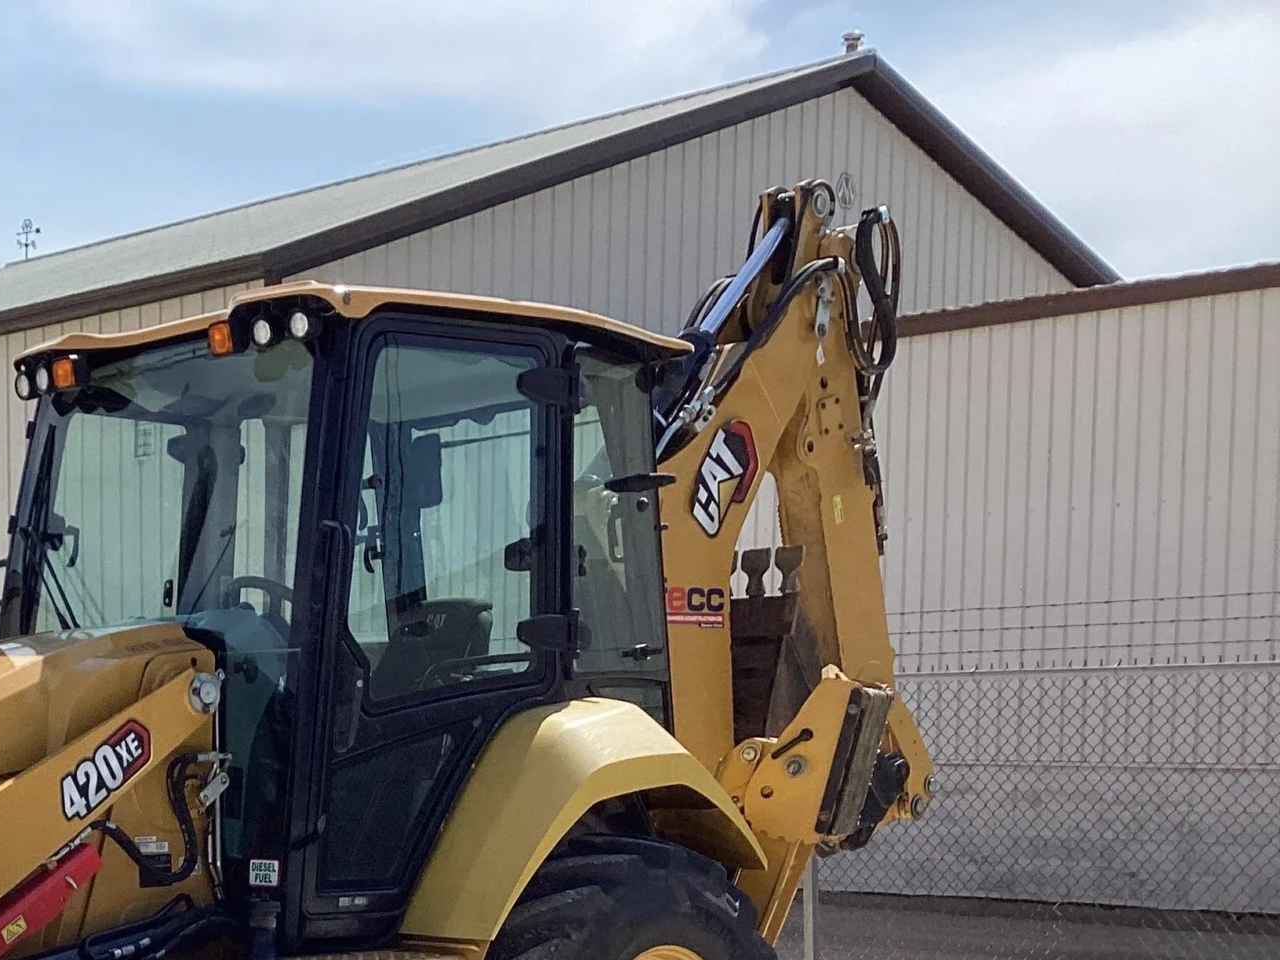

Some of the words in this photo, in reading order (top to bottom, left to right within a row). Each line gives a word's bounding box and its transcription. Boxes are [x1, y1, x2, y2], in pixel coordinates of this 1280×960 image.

[692, 427, 744, 535] CAT
[251, 861, 277, 873] DIESEL
[254, 872, 273, 884] FUEL
